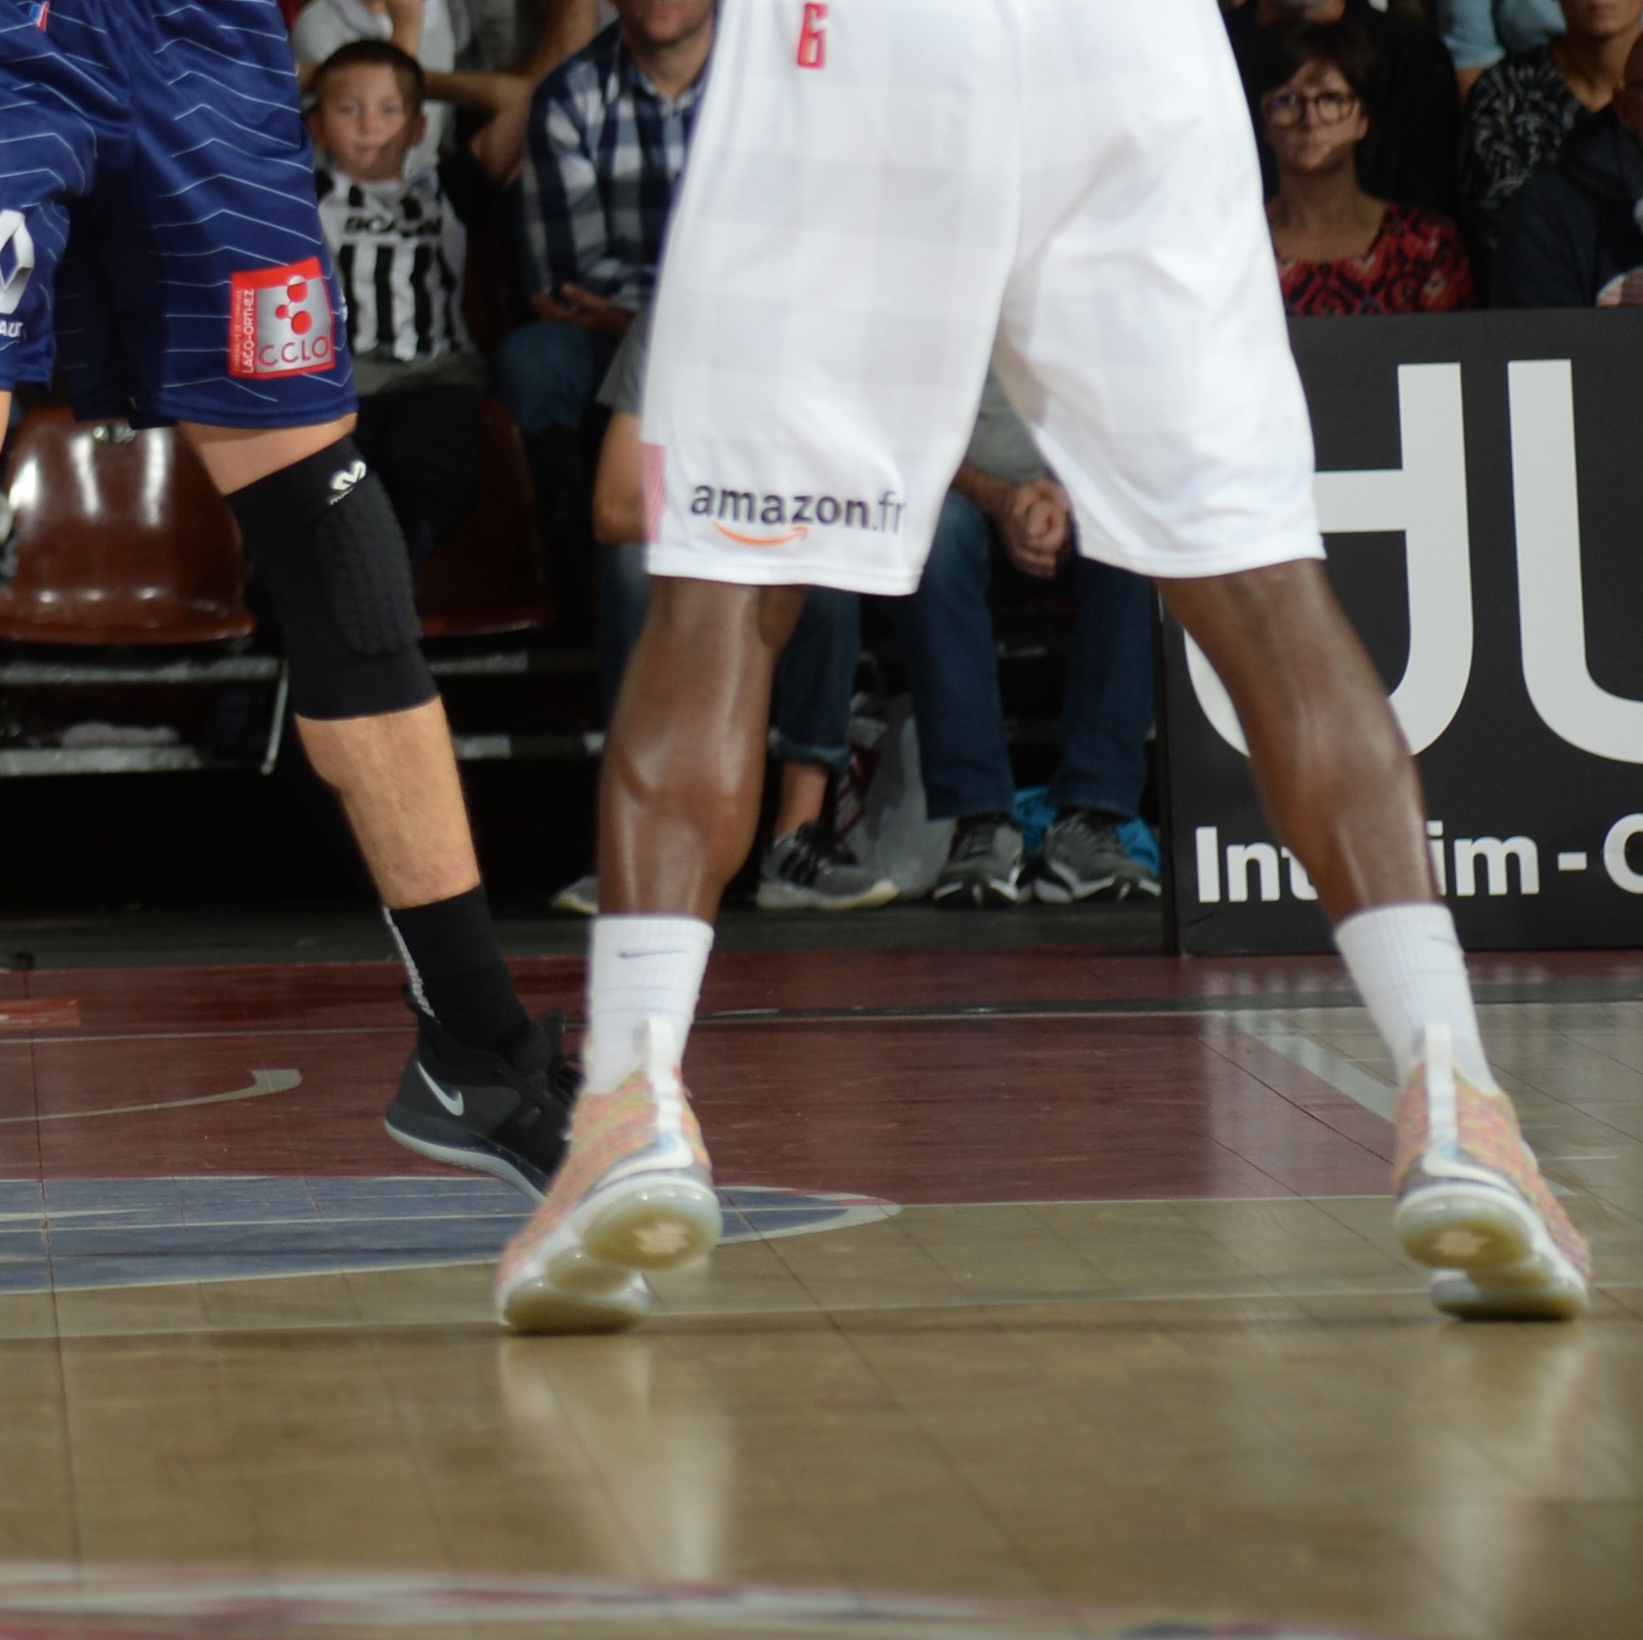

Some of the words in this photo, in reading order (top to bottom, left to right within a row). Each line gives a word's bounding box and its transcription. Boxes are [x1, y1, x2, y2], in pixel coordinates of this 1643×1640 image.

[796, 1, 829, 70] 6
[258, 335, 331, 368] CCLO
[690, 484, 907, 535] amazon.fr
[1195, 820, 1540, 904] Intim
